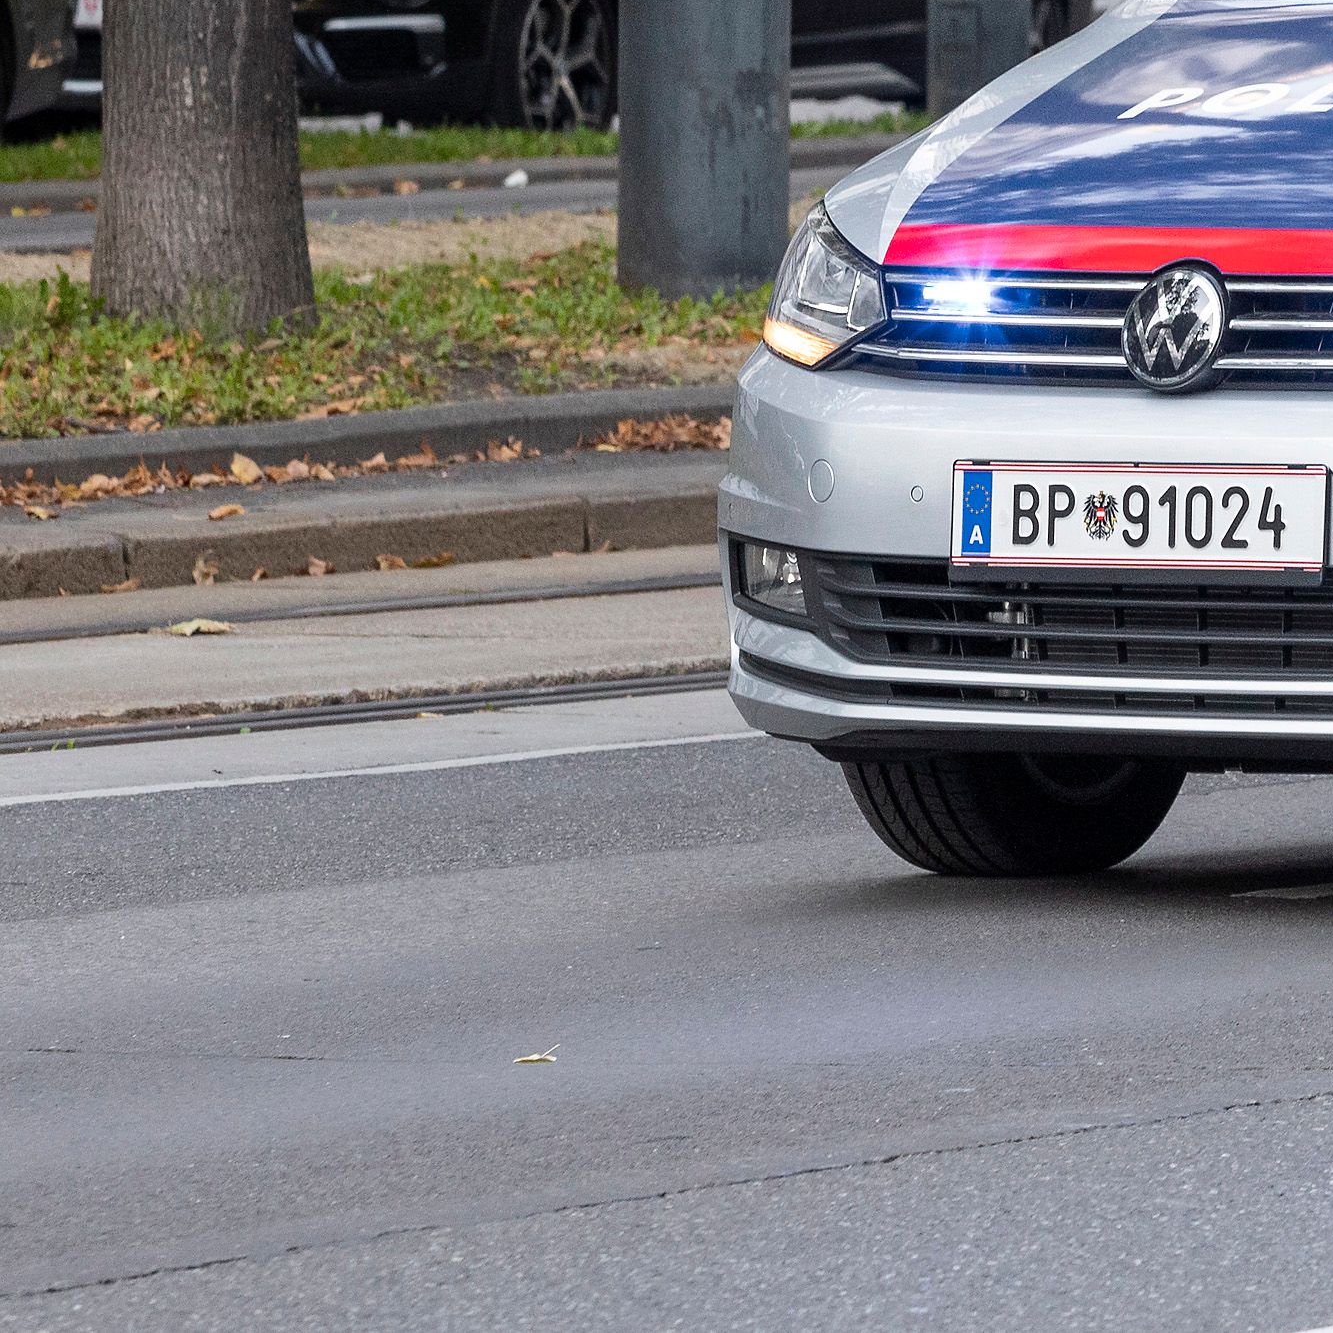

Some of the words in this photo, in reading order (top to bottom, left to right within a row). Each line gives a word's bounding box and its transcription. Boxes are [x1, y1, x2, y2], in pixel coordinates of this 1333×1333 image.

[969, 524, 983, 545] A
[1012, 484, 1076, 547] BP
[1122, 484, 1286, 549] 91024
